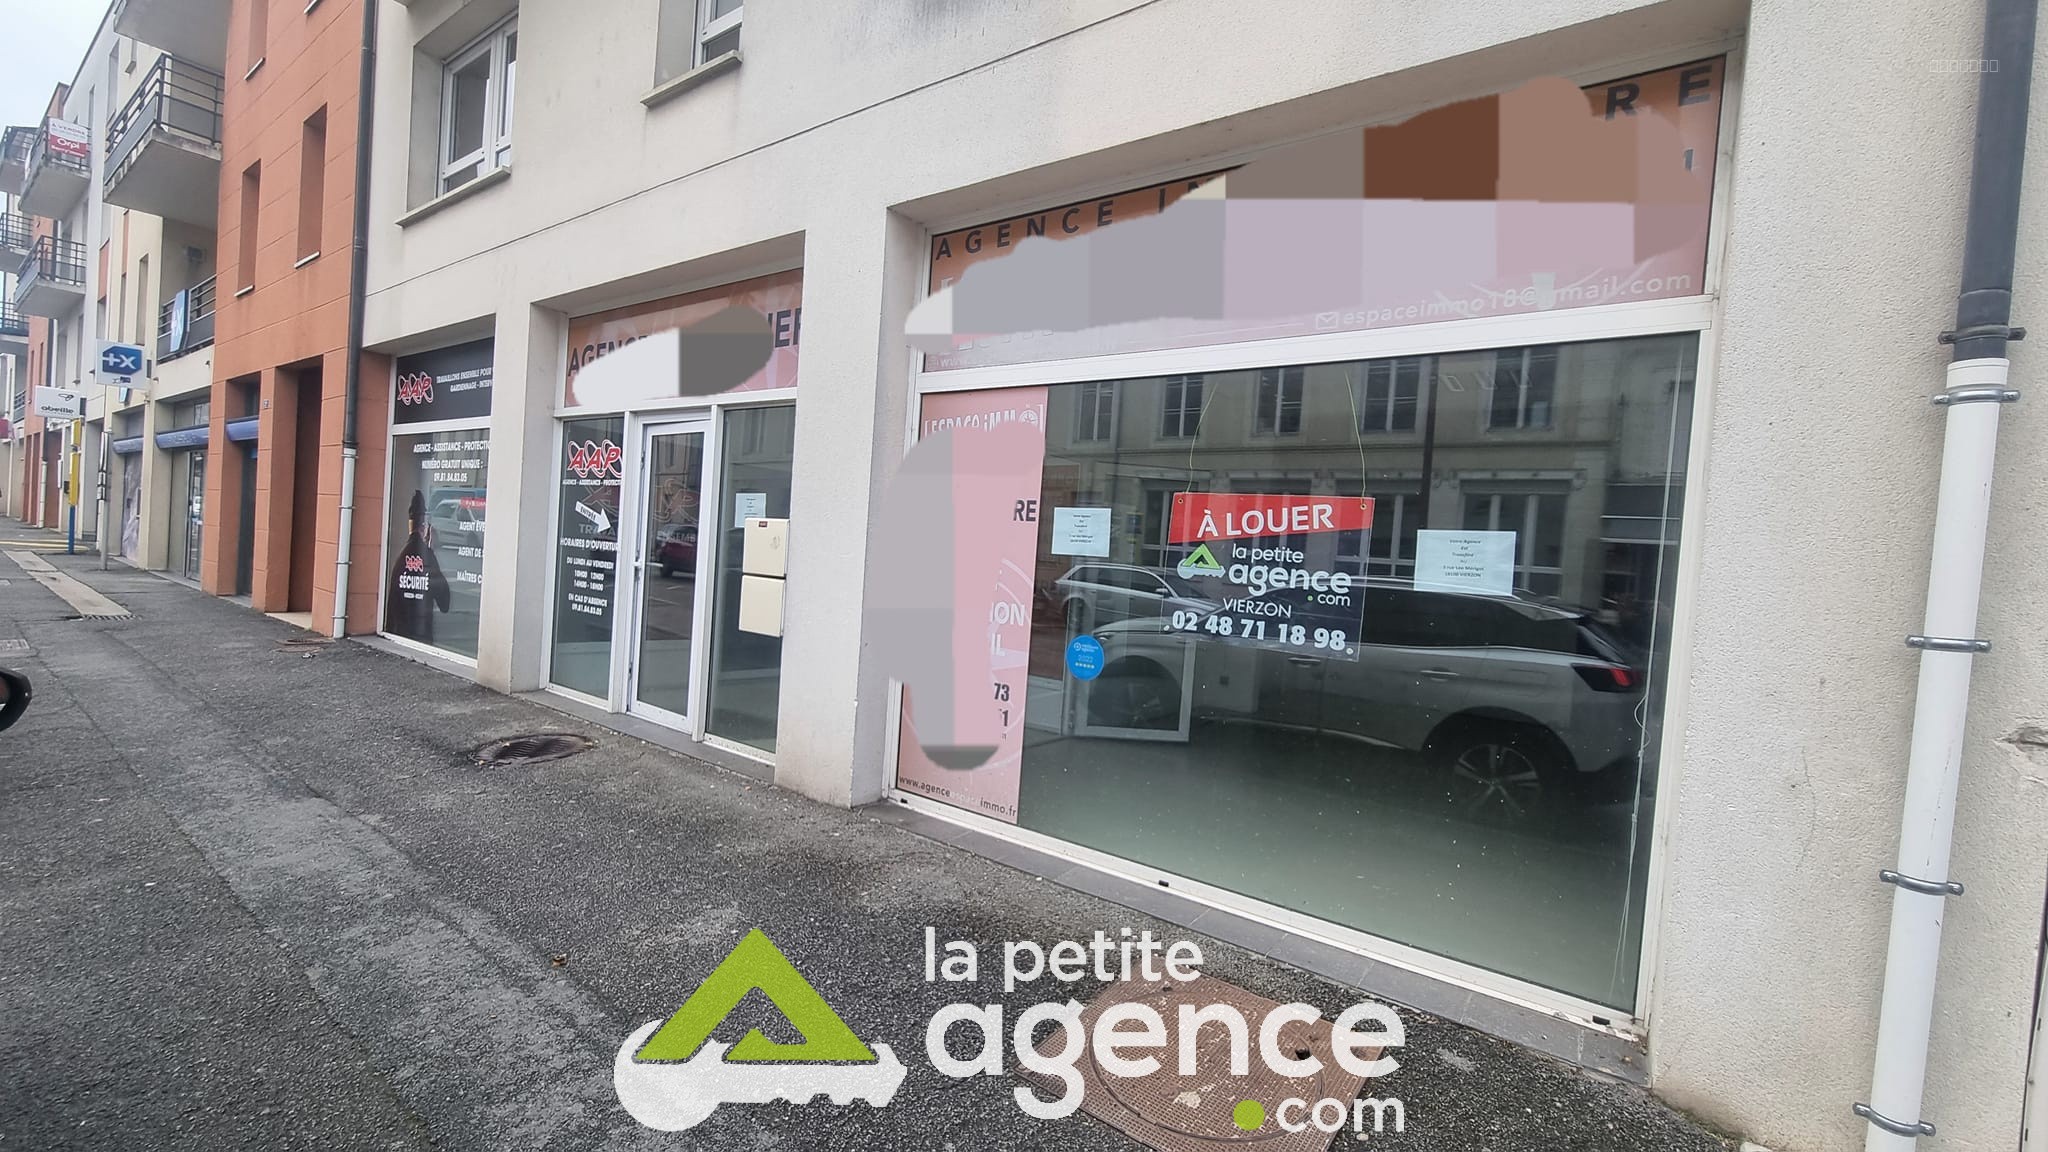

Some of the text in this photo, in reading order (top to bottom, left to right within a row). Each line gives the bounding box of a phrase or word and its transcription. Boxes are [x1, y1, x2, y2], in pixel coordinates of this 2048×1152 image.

[57, 138, 80, 150] Orpi
[936, 200, 1113, 261] AGENCE
[413, 443, 431, 453] AGENCE
[433, 441, 461, 452] ASSISTANCE
[421, 457, 440, 469] NUMÉRO
[441, 459, 460, 469] GRATUIT
[567, 442, 622, 475] AAP
[459, 521, 475, 532] AGENT
[1197, 504, 1334, 538] À LOUER
[458, 546, 482, 558] AGENT DE
[560, 537, 585, 549] HORAIRES
[1231, 543, 1304, 563] la petite
[399, 571, 429, 590] SÉCURITÉ
[456, 570, 476, 583] MAÎTRES
[1228, 563, 1351, 596] agence
[1223, 597, 1292, 619] VIERZON
[1172, 610, 1346, 650] 02 48 71 18 98
